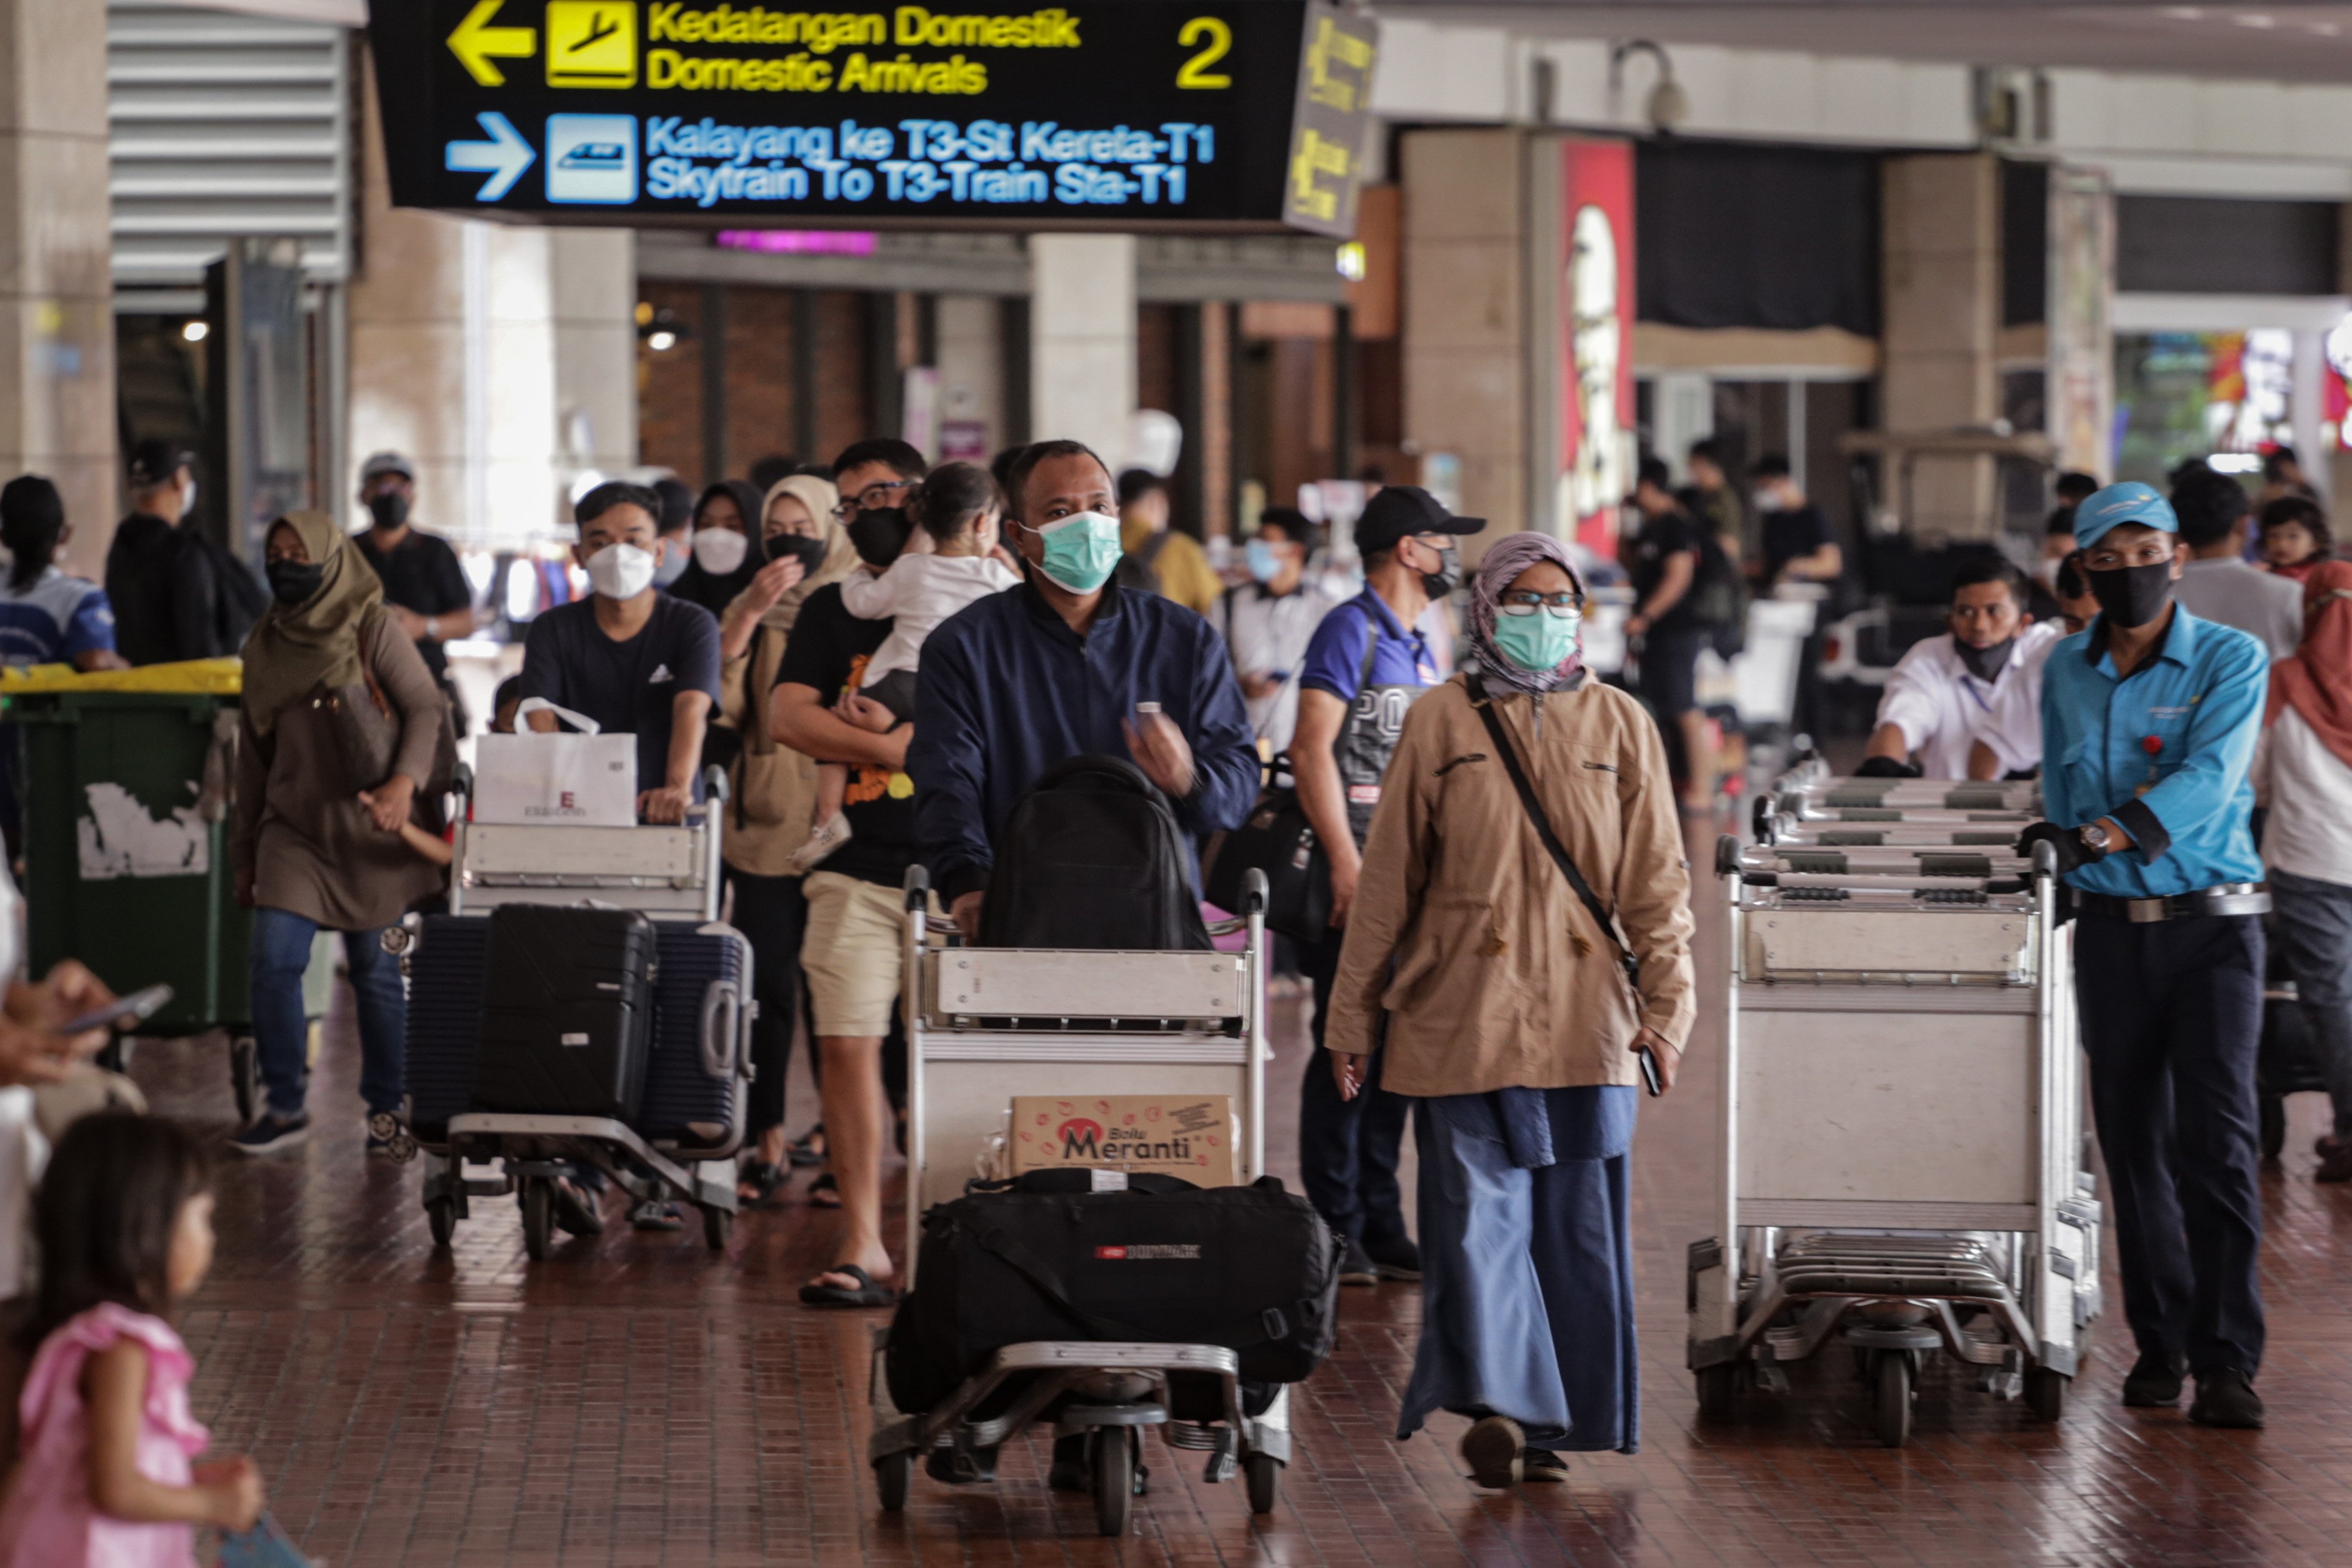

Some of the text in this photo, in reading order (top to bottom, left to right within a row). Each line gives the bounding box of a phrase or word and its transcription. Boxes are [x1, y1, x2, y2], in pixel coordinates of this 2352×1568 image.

[648, 3, 1080, 54] Kedatangan Domestik
[1176, 17, 1231, 89] 2
[647, 49, 987, 94] Domestic Arrivals
[646, 116, 1214, 170] Kalayang ke T3-St Kereta-T1
[646, 158, 1187, 207] Skytrain To T3-Train Sta-T1
[1064, 1126, 1191, 1159] Meranti
